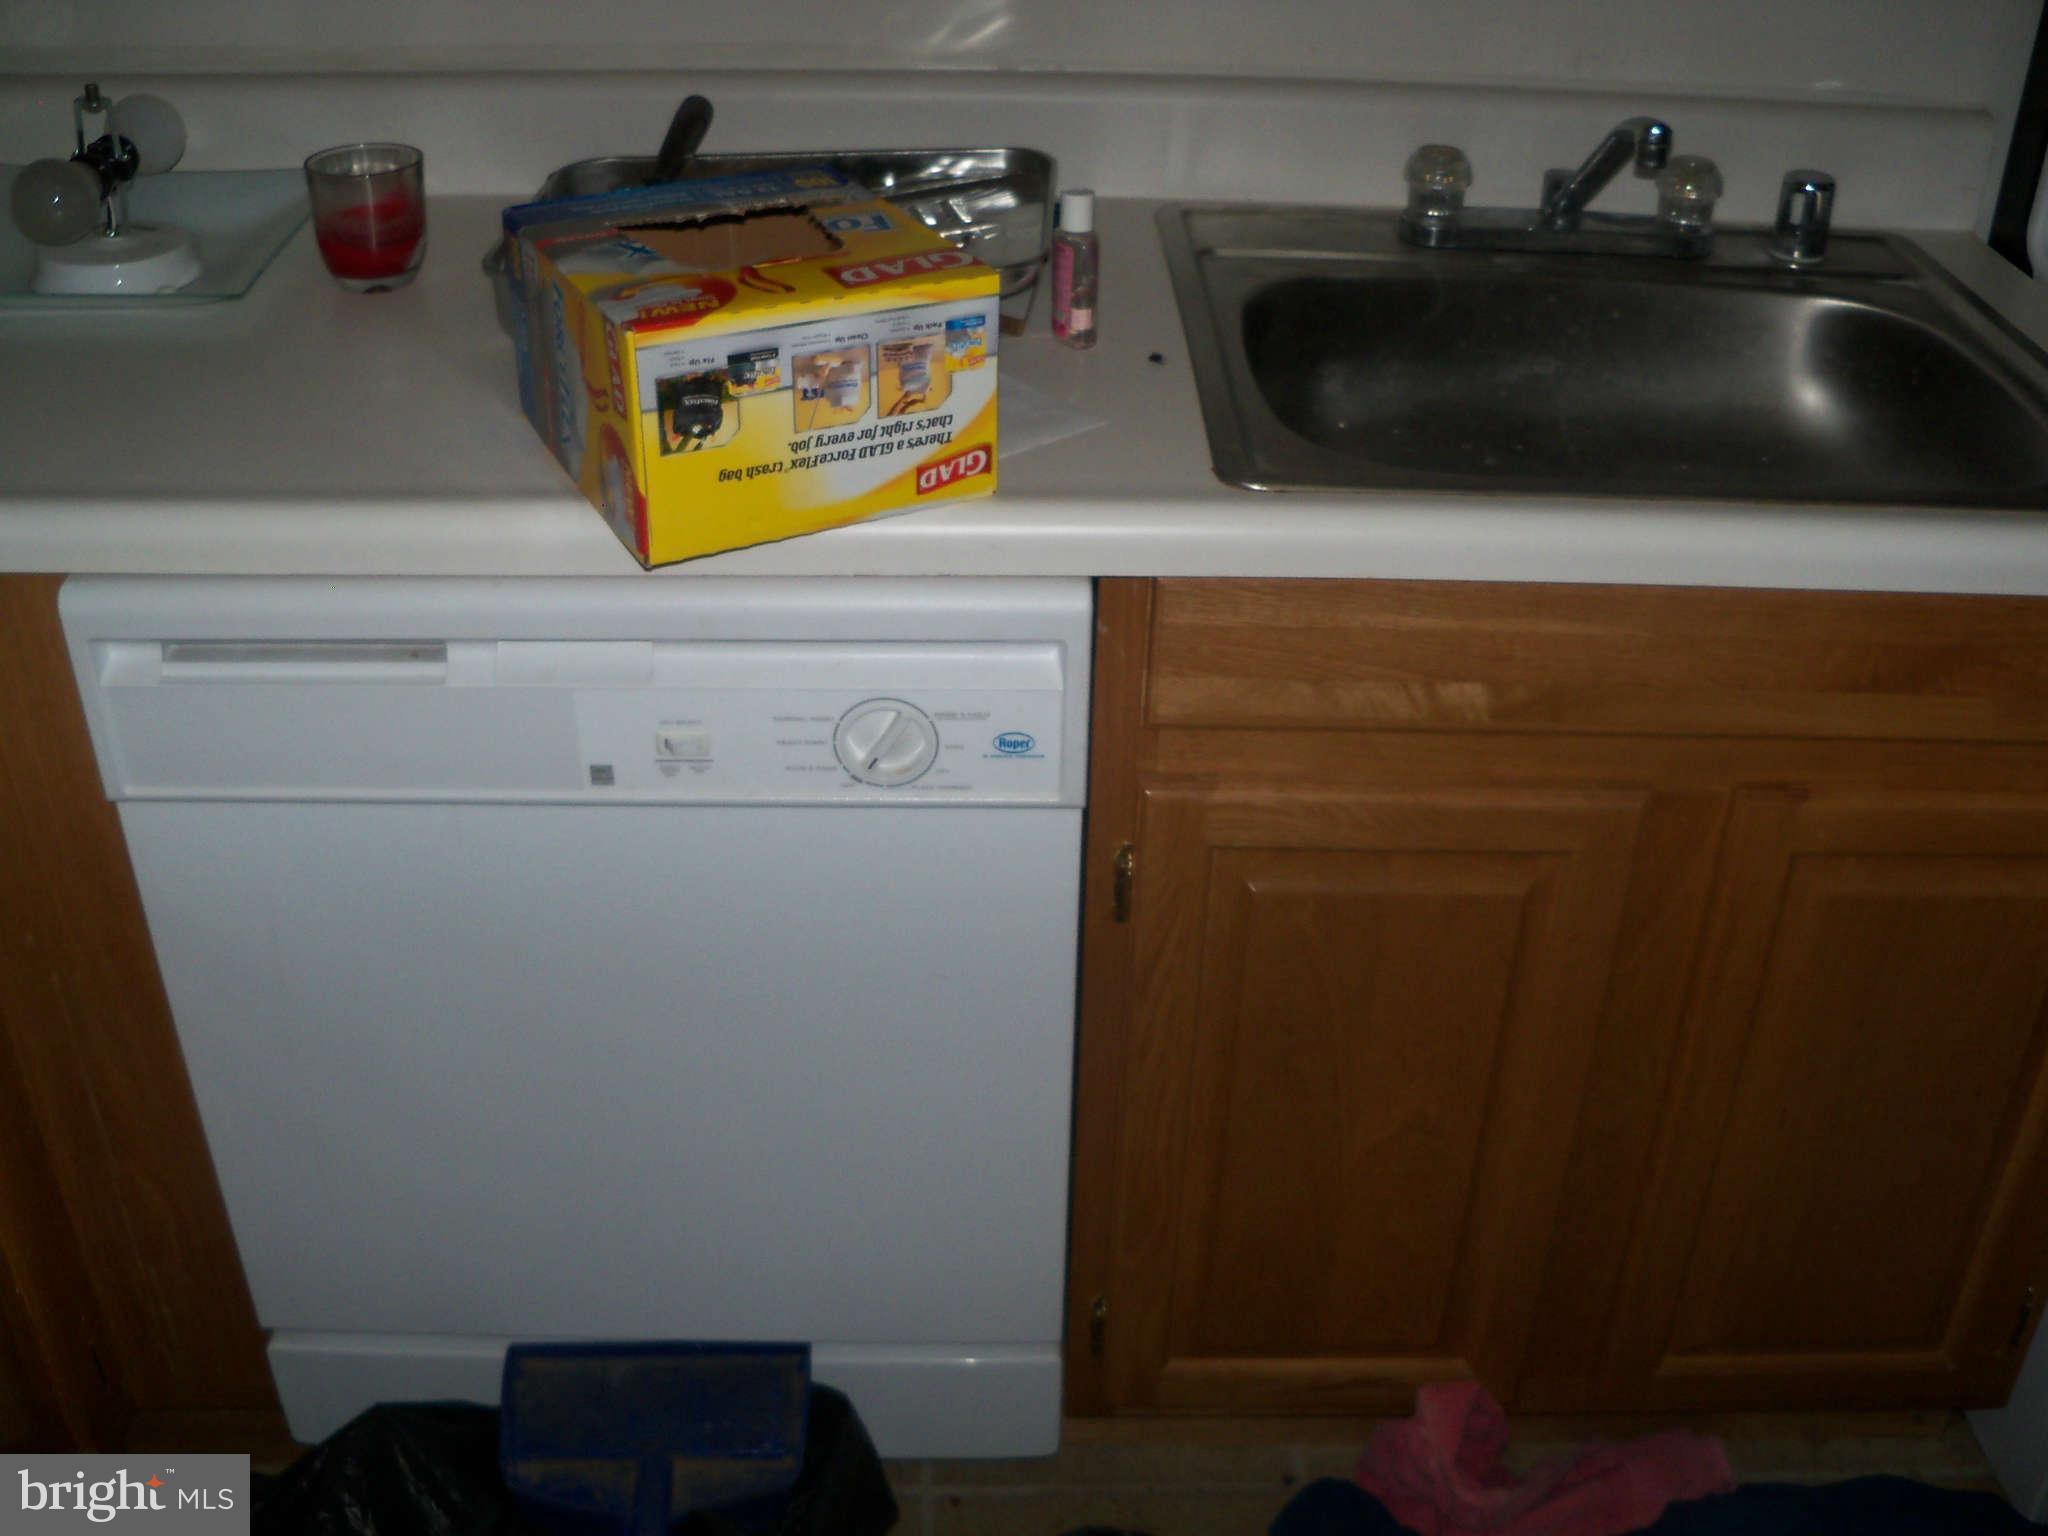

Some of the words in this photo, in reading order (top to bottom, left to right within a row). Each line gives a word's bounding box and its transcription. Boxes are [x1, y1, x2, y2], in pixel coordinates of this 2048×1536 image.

[840, 251, 974, 283] GLAD
[878, 421, 913, 438] right
[914, 414, 953, 431] that's
[816, 430, 855, 448] every
[857, 425, 878, 442] for
[903, 431, 953, 449] There's
[788, 436, 814, 453] job.
[858, 440, 894, 459] GLAD
[790, 446, 855, 471] ForceFlex
[718, 468, 743, 482] bag
[746, 462, 784, 479] trash
[919, 449, 988, 489] GLAD
[998, 734, 1032, 751] Roper
